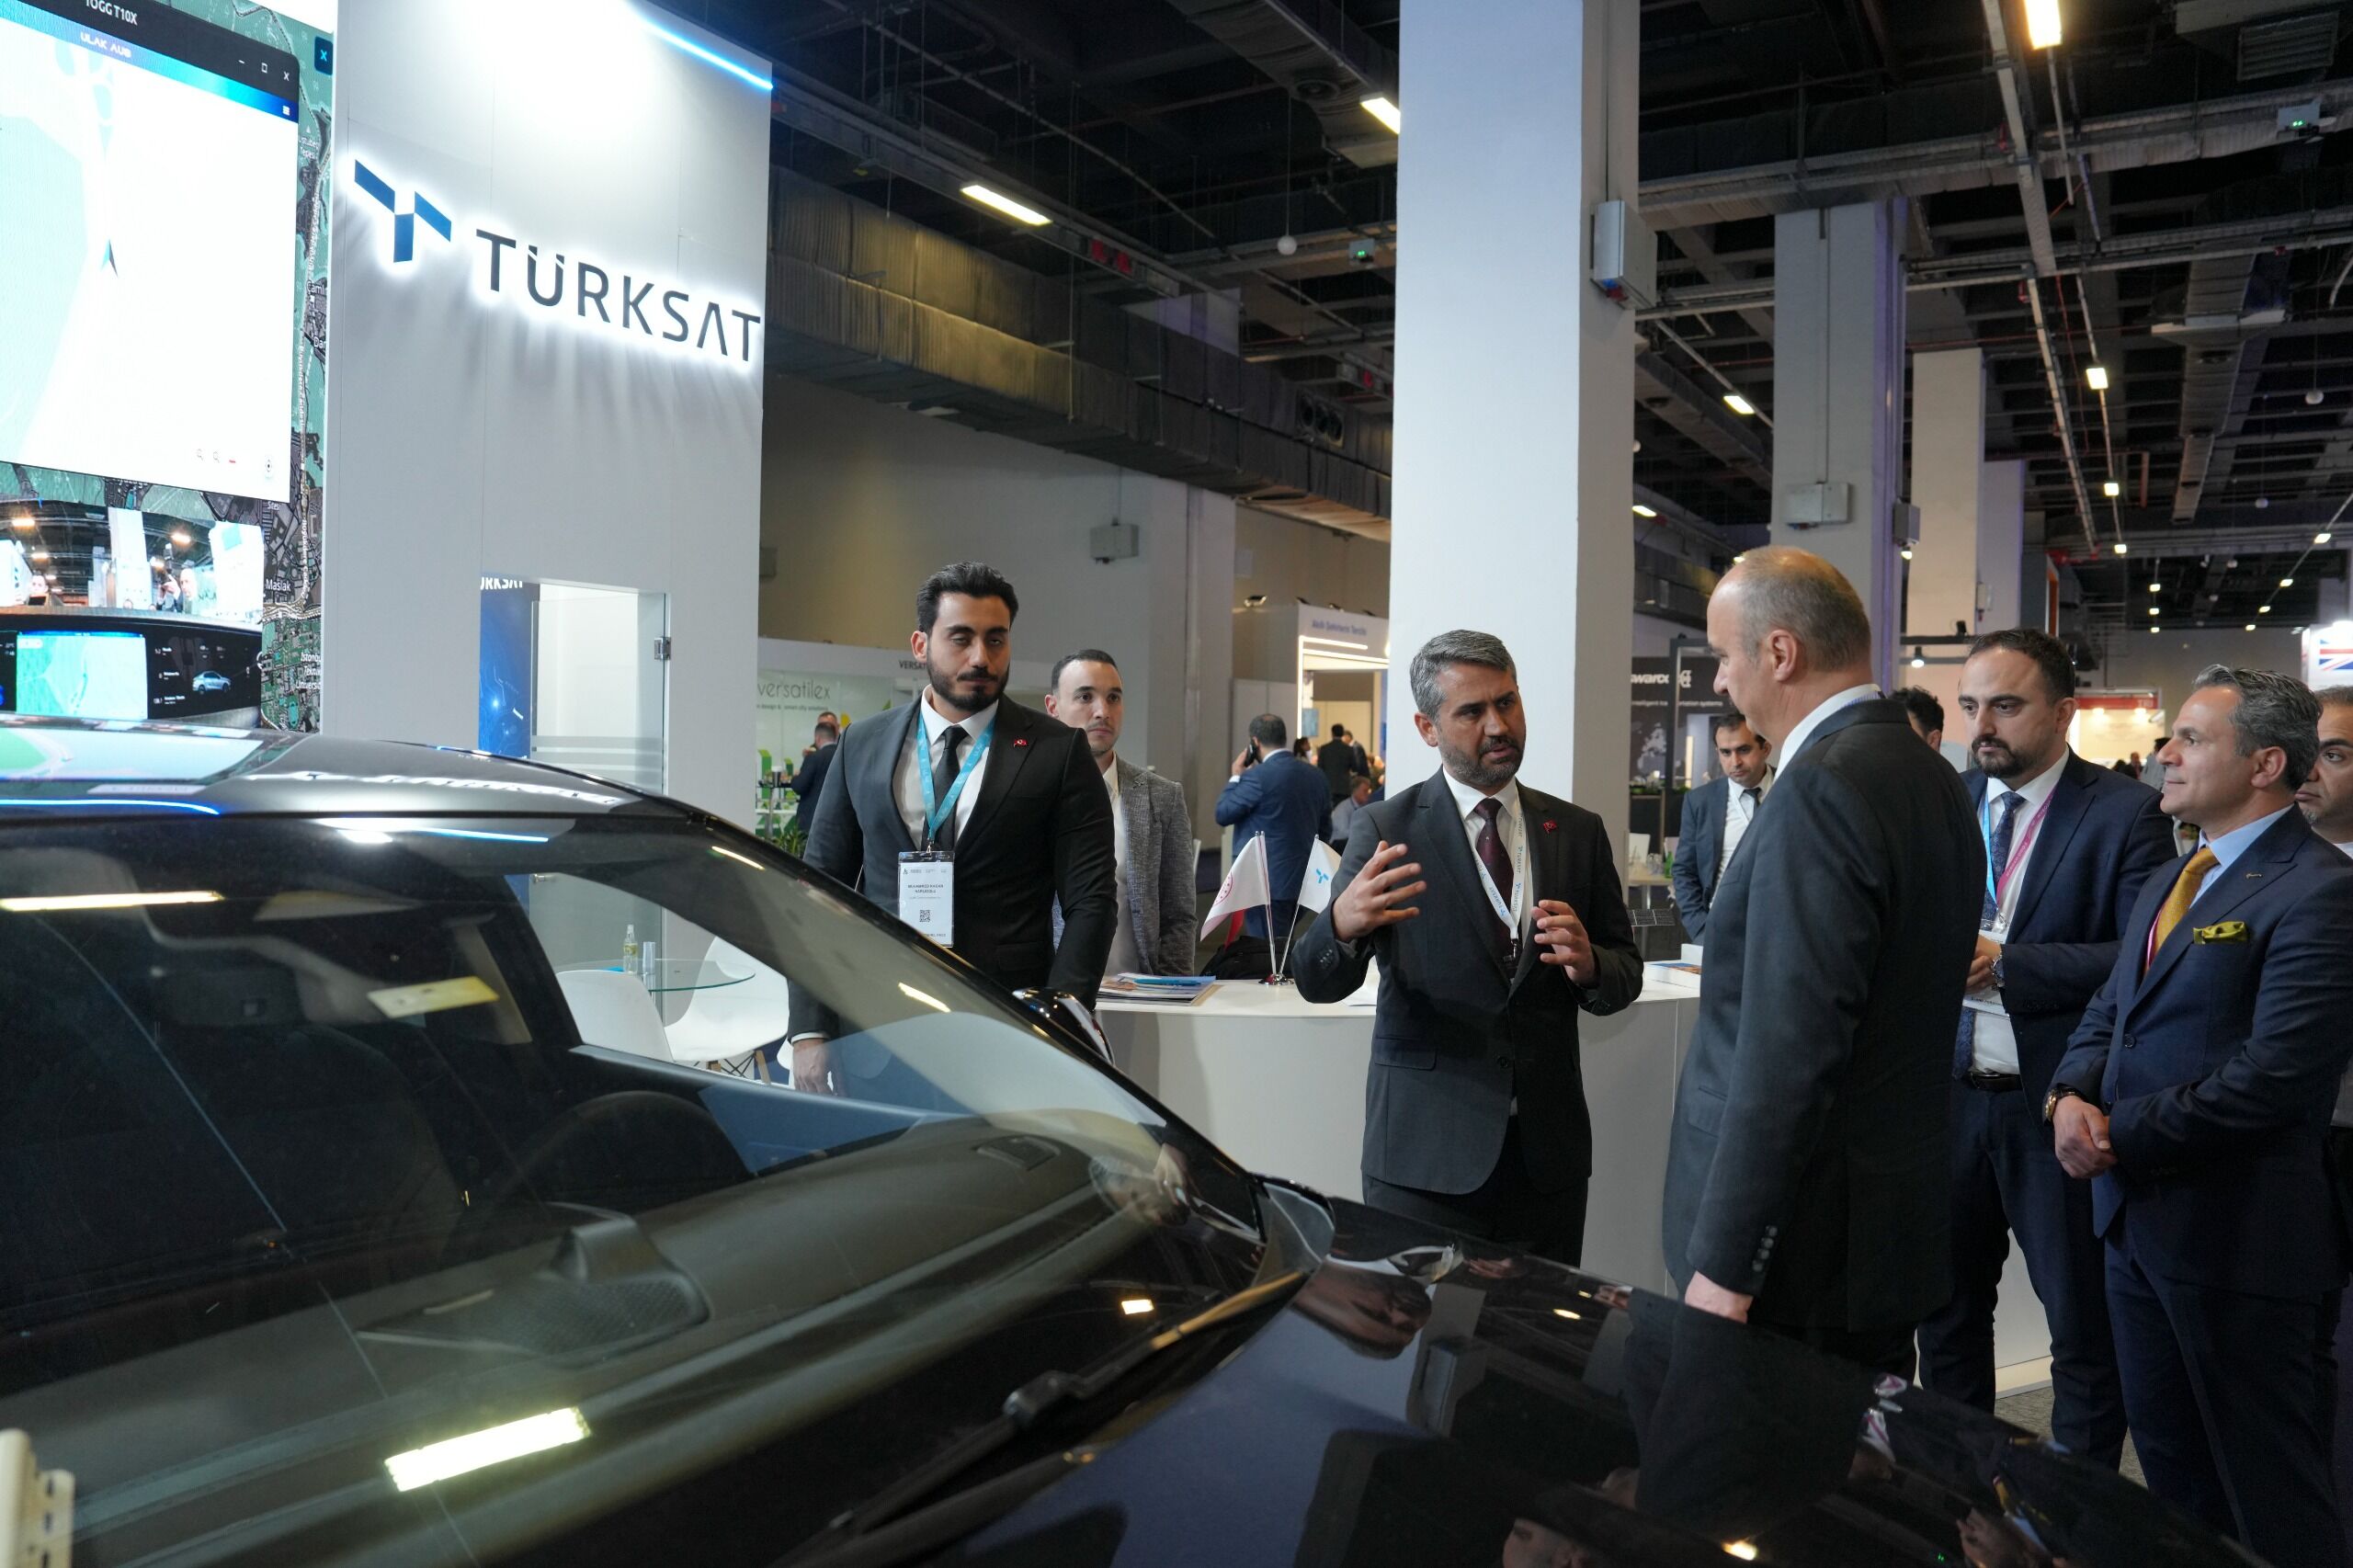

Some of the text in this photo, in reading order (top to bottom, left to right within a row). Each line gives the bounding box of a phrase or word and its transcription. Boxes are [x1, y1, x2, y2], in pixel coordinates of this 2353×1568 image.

[113, 5, 138, 26] T10X
[476, 229, 761, 361] TÜRKSAT
[266, 578, 291, 592] Maslak
[757, 679, 831, 699] versatilex
